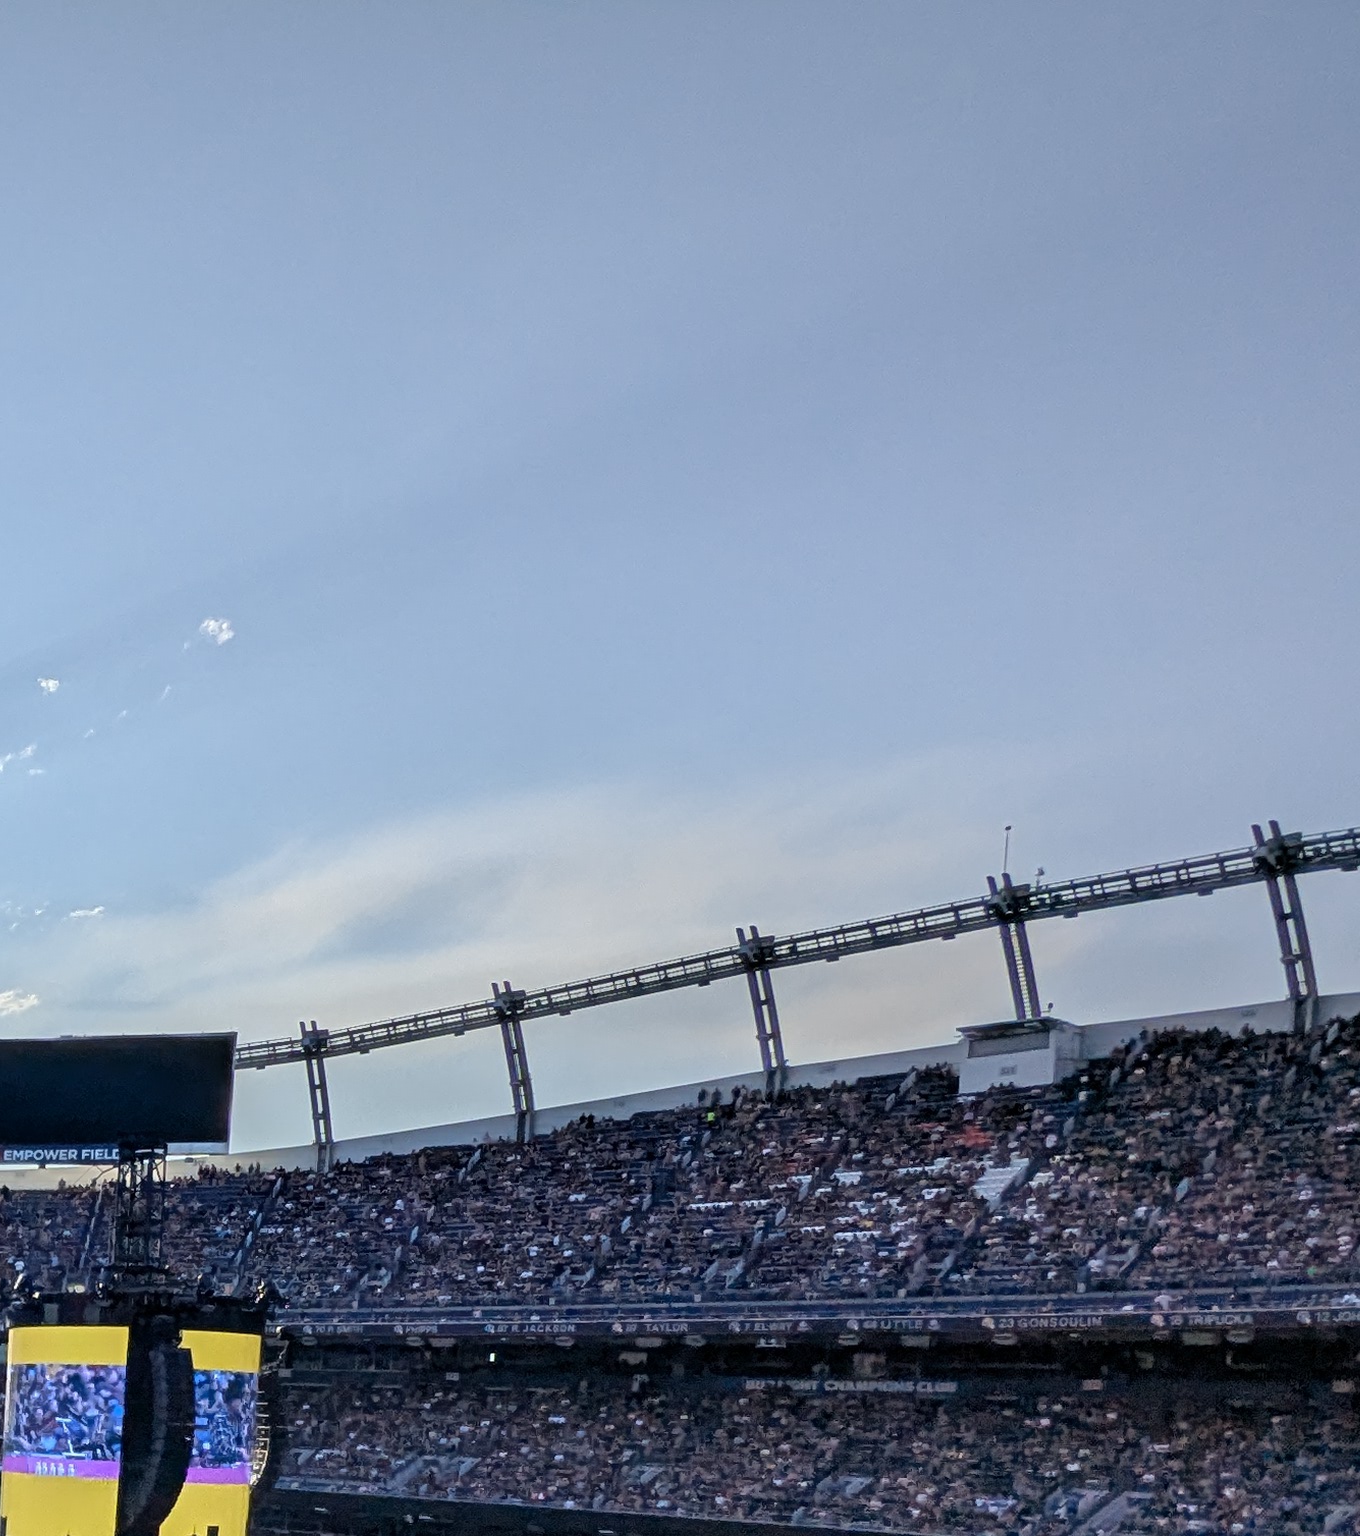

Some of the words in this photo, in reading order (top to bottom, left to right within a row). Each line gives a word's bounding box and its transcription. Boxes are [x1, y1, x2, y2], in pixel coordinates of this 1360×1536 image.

[3, 1148, 78, 1161] EMPOWER
[81, 1148, 120, 1160] FIELD
[645, 1323, 689, 1332] TAYLOR
[998, 1317, 1015, 1329] 23
[1017, 1316, 1102, 1329] GONSOULIN
[522, 1324, 576, 1333] JACKSON
